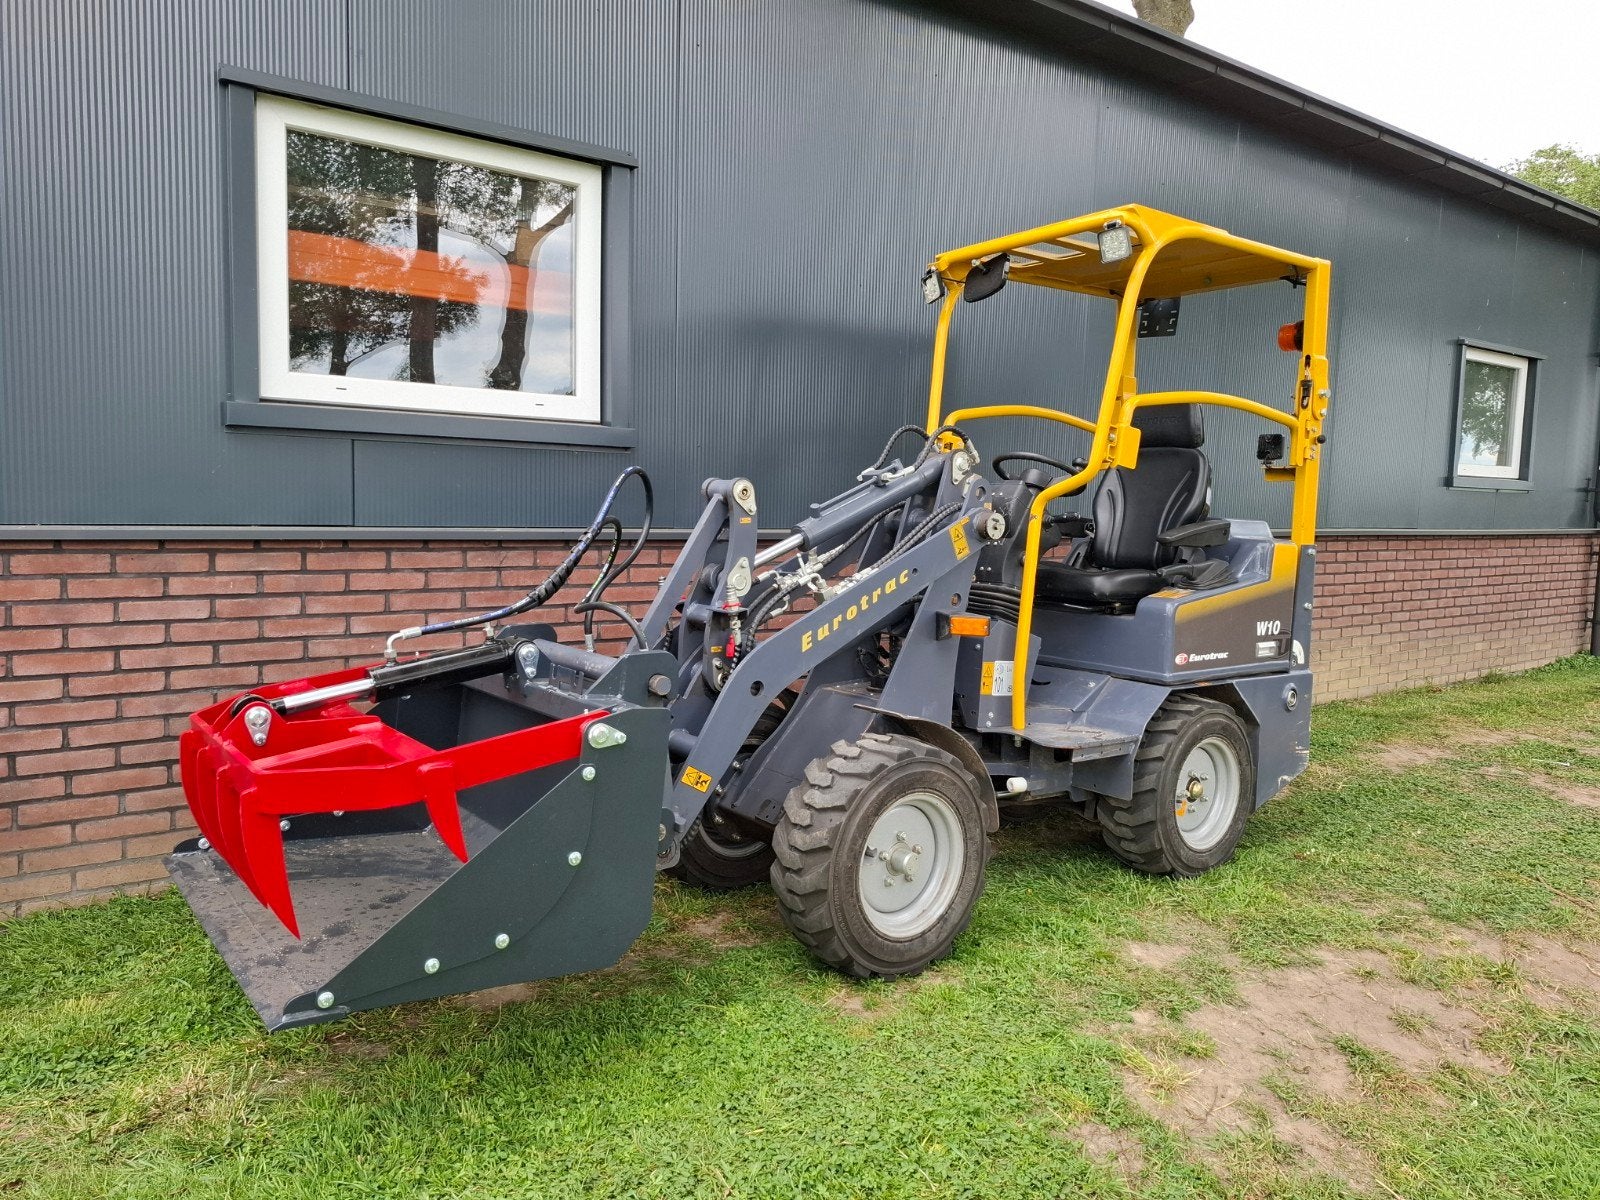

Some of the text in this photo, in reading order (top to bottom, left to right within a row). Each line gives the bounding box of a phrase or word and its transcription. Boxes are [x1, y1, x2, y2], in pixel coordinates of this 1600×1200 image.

[801, 569, 909, 653] Eurotrac
[1256, 620, 1281, 636] W10
[1189, 652, 1229, 662] Eurotrac
